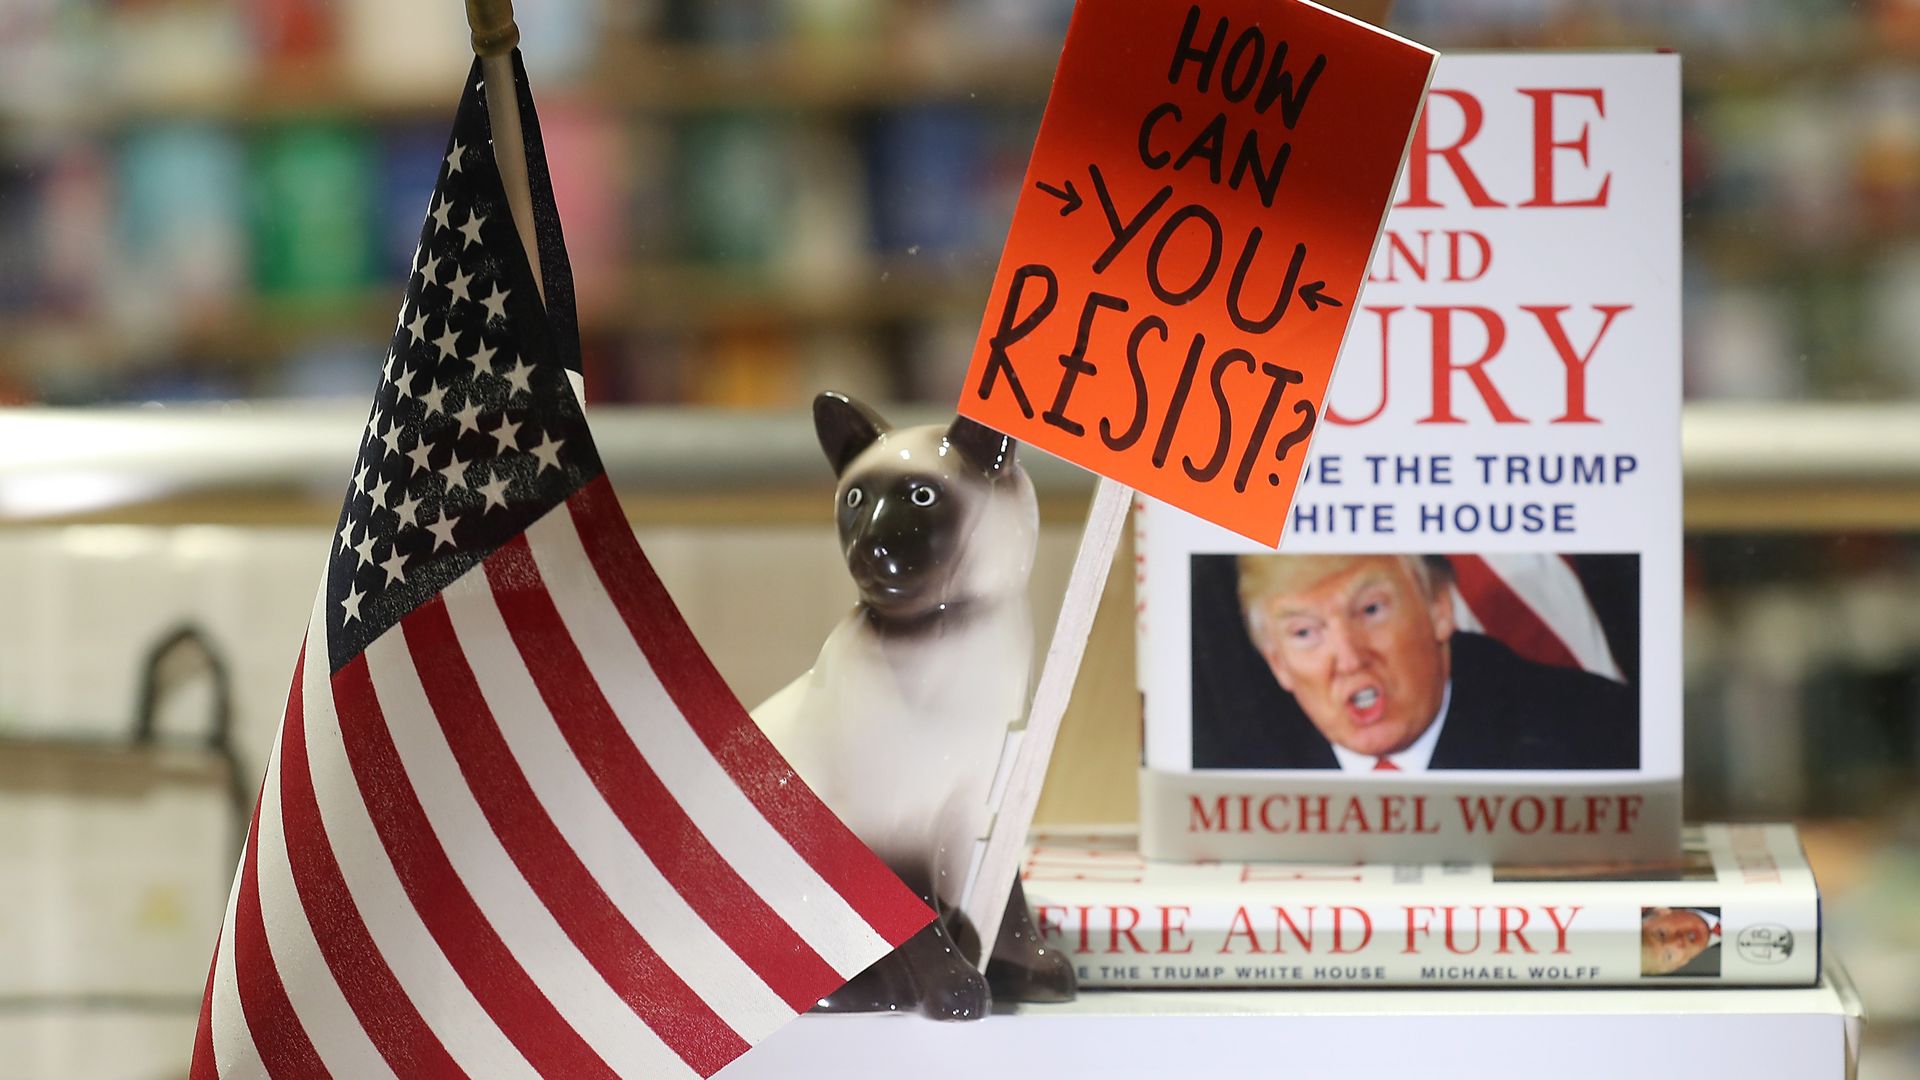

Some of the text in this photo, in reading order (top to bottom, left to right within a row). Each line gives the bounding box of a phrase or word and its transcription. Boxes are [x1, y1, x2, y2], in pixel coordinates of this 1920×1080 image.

[1168, 4, 1328, 130] HOW
[1138, 103, 1292, 207] CAN
[1393, 88, 1612, 210] RE
[1088, 164, 1307, 335] YOU
[1369, 230, 1493, 283] ND
[977, 264, 1317, 494] RESIST?
[1365, 454, 1454, 486] THE
[1475, 454, 1639, 486] TRUMP
[1294, 503, 1578, 536] HITE HOUSE
[1188, 794, 1643, 835] MICHAEL WOLFF
[1034, 904, 1583, 956] FIRE AND FURY
[1101, 966, 1140, 979] THE
[1152, 966, 1225, 979] TRUMP
[1235, 966, 1303, 980] WHITE
[1314, 966, 1385, 980] HOUSE
[1420, 966, 1601, 980] MICHAEL WOLFF
